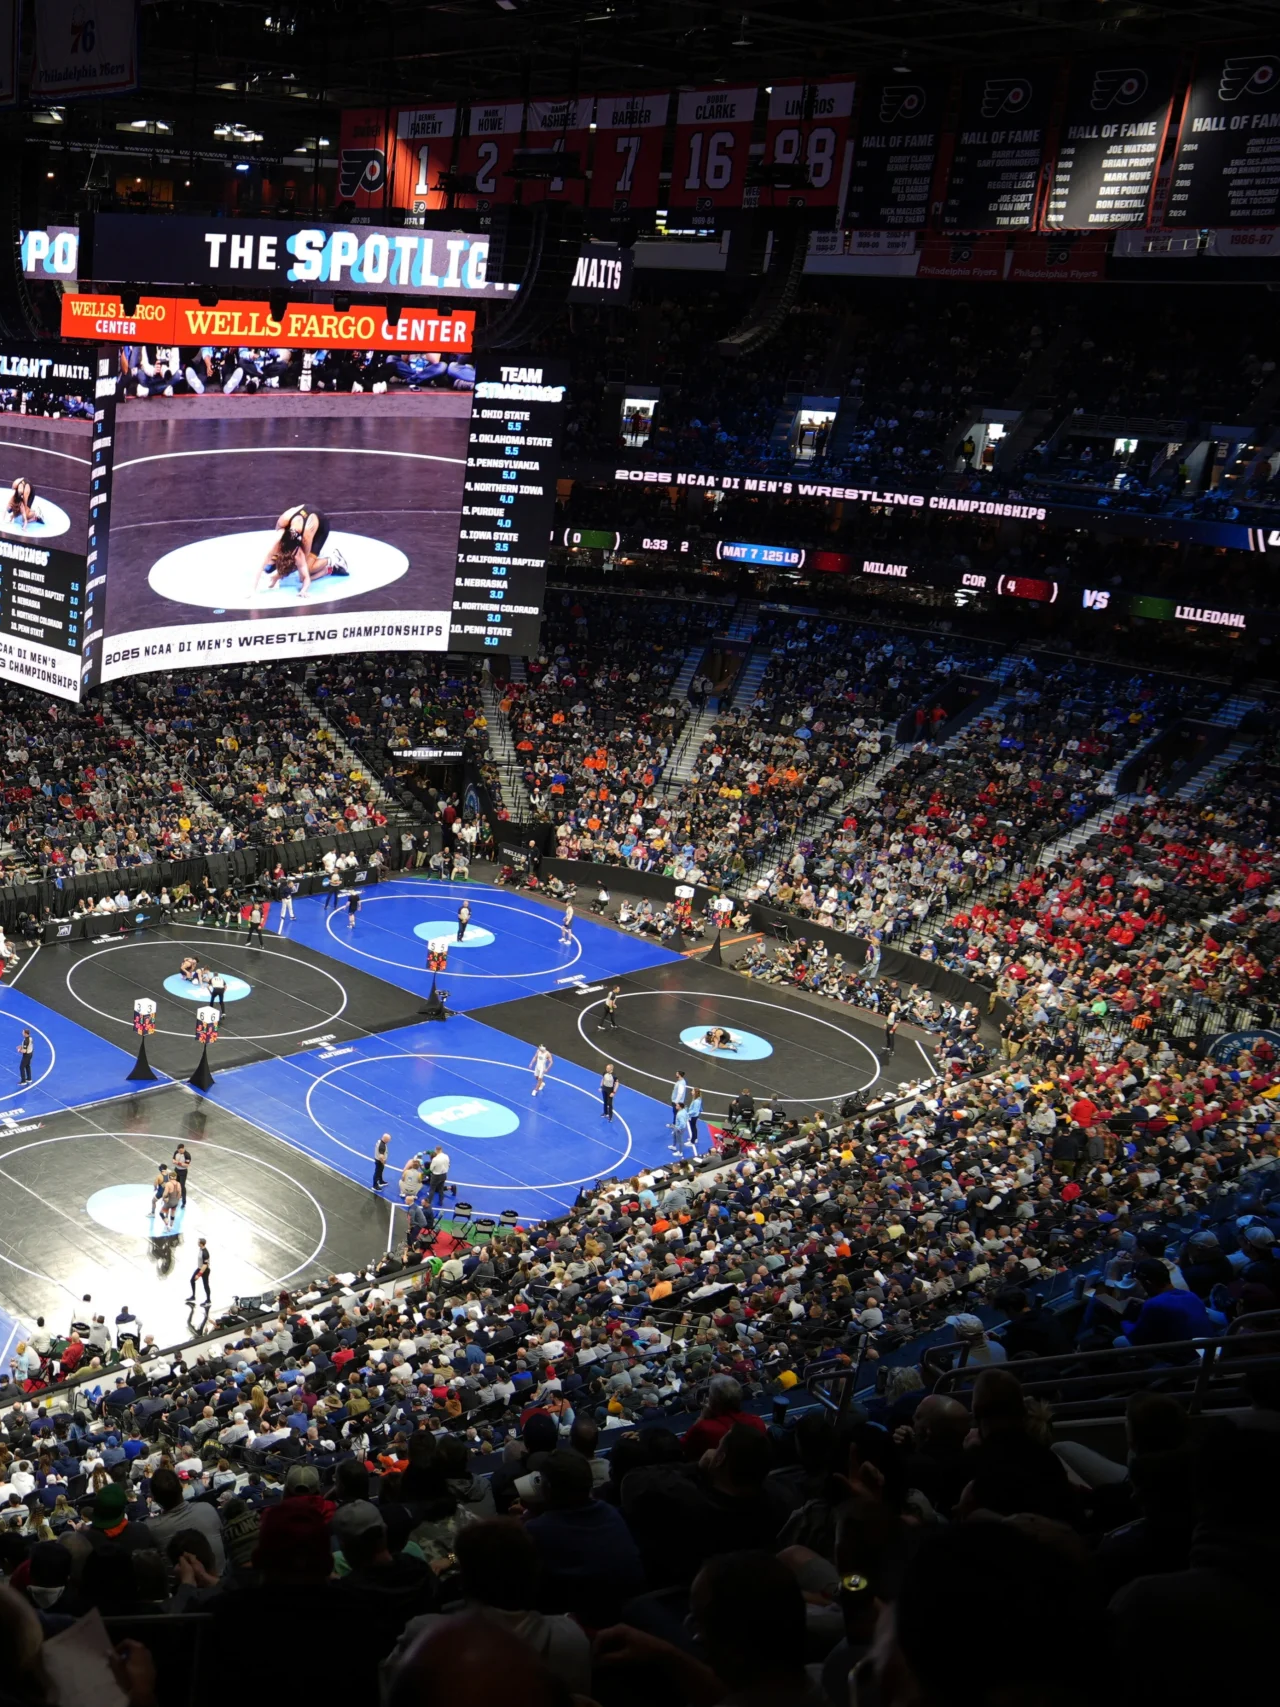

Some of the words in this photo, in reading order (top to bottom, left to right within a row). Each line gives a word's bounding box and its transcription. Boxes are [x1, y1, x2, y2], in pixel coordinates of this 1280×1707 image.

[695, 104, 736, 121] CLARKE
[785, 99, 835, 115] LINROS
[478, 118, 503, 132] HOWE
[612, 110, 651, 126] BARBER
[410, 121, 443, 137] PARENT
[1068, 125, 1098, 139] HALL
[1101, 123, 1118, 138] OF
[1120, 122, 1157, 137] FAME
[476, 141, 499, 194] 2
[616, 136, 641, 192] 7
[685, 131, 735, 190] 16
[1102, 158, 1123, 168] BRIAN
[414, 144, 429, 196] 1
[1103, 172, 1123, 181] MARK
[1099, 186, 1119, 195] DAVE
[1096, 200, 1113, 209] RON
[1088, 213, 1110, 223] DAVE
[20, 231, 77, 275] PO
[205, 232, 278, 270] THE
[287, 229, 518, 292] SPOTLIG
[71, 301, 117, 318] WELLS
[119, 304, 166, 322] FRGO
[96, 320, 137, 335] CENTER
[185, 309, 282, 338] WELLS
[287, 314, 375, 340] FARGO
[380, 318, 466, 343] CENTER
[500, 366, 543, 384] TEAM
[481, 409, 503, 420] OHIO
[504, 411, 530, 421] STATE
[507, 421, 522, 431] 5.5
[469, 433, 478, 443] 2.
[478, 434, 525, 446] OKLAHOMA
[526, 437, 553, 448] STATE
[505, 446, 519, 455] 5.5
[476, 458, 539, 471] PENNSYLVANIA
[502, 471, 517, 480] 5.0
[465, 482, 473, 491] 4.
[474, 483, 518, 494] NORTHERN
[519, 485, 543, 496] IOWA
[615, 469, 672, 484] 2025
[722, 476, 740, 490] DI
[745, 477, 792, 495] MEN'S
[797, 484, 924, 507] WRESTLING
[929, 497, 1046, 520] CHAMPIONSHIPS
[499, 495, 514, 504] 4.0
[462, 506, 470, 515] 5.
[471, 507, 505, 517] PURDUE
[497, 519, 512, 528] 4.0
[469, 530, 492, 541] IOWA
[493, 532, 519, 542] STATE
[495, 543, 509, 551] 3.5
[642, 538, 668, 551] 0:33
[681, 541, 689, 553] 2
[458, 554, 465, 563] 7.
[466, 555, 511, 565] CALIFORNIA
[512, 558, 545, 568] BAPTIST
[723, 545, 747, 559] MAT
[751, 547, 758, 559] 7
[762, 549, 784, 562] 125
[785, 551, 799, 564] LB
[492, 567, 506, 575] 3.0
[863, 561, 907, 578] MILANI
[464, 578, 508, 589] NEBRASKA
[962, 572, 986, 588] COR
[1007, 580, 1015, 592] 4
[489, 591, 504, 599] 3.0
[1083, 588, 1110, 611] VS
[461, 601, 500, 612] NORTHERN
[500, 604, 539, 615] COLORADO
[487, 614, 501, 622] 3.0
[1174, 605, 1247, 628] LILLEDAHL
[463, 625, 486, 635] PENN
[487, 627, 513, 637] STATE
[104, 647, 141, 666] 2025
[179, 642, 192, 653] DI
[197, 638, 233, 652] MEN'S
[238, 629, 338, 647] WRESTLING
[342, 626, 442, 639] CHAMPIONSHIPS
[484, 637, 499, 646] 3.0
[18, 648, 27, 660] DI
[31, 651, 56, 668] MEN'S
[10, 660, 78, 691] CHAMPIONSHIPS
[403, 750, 443, 758] SPOTLIGHT
